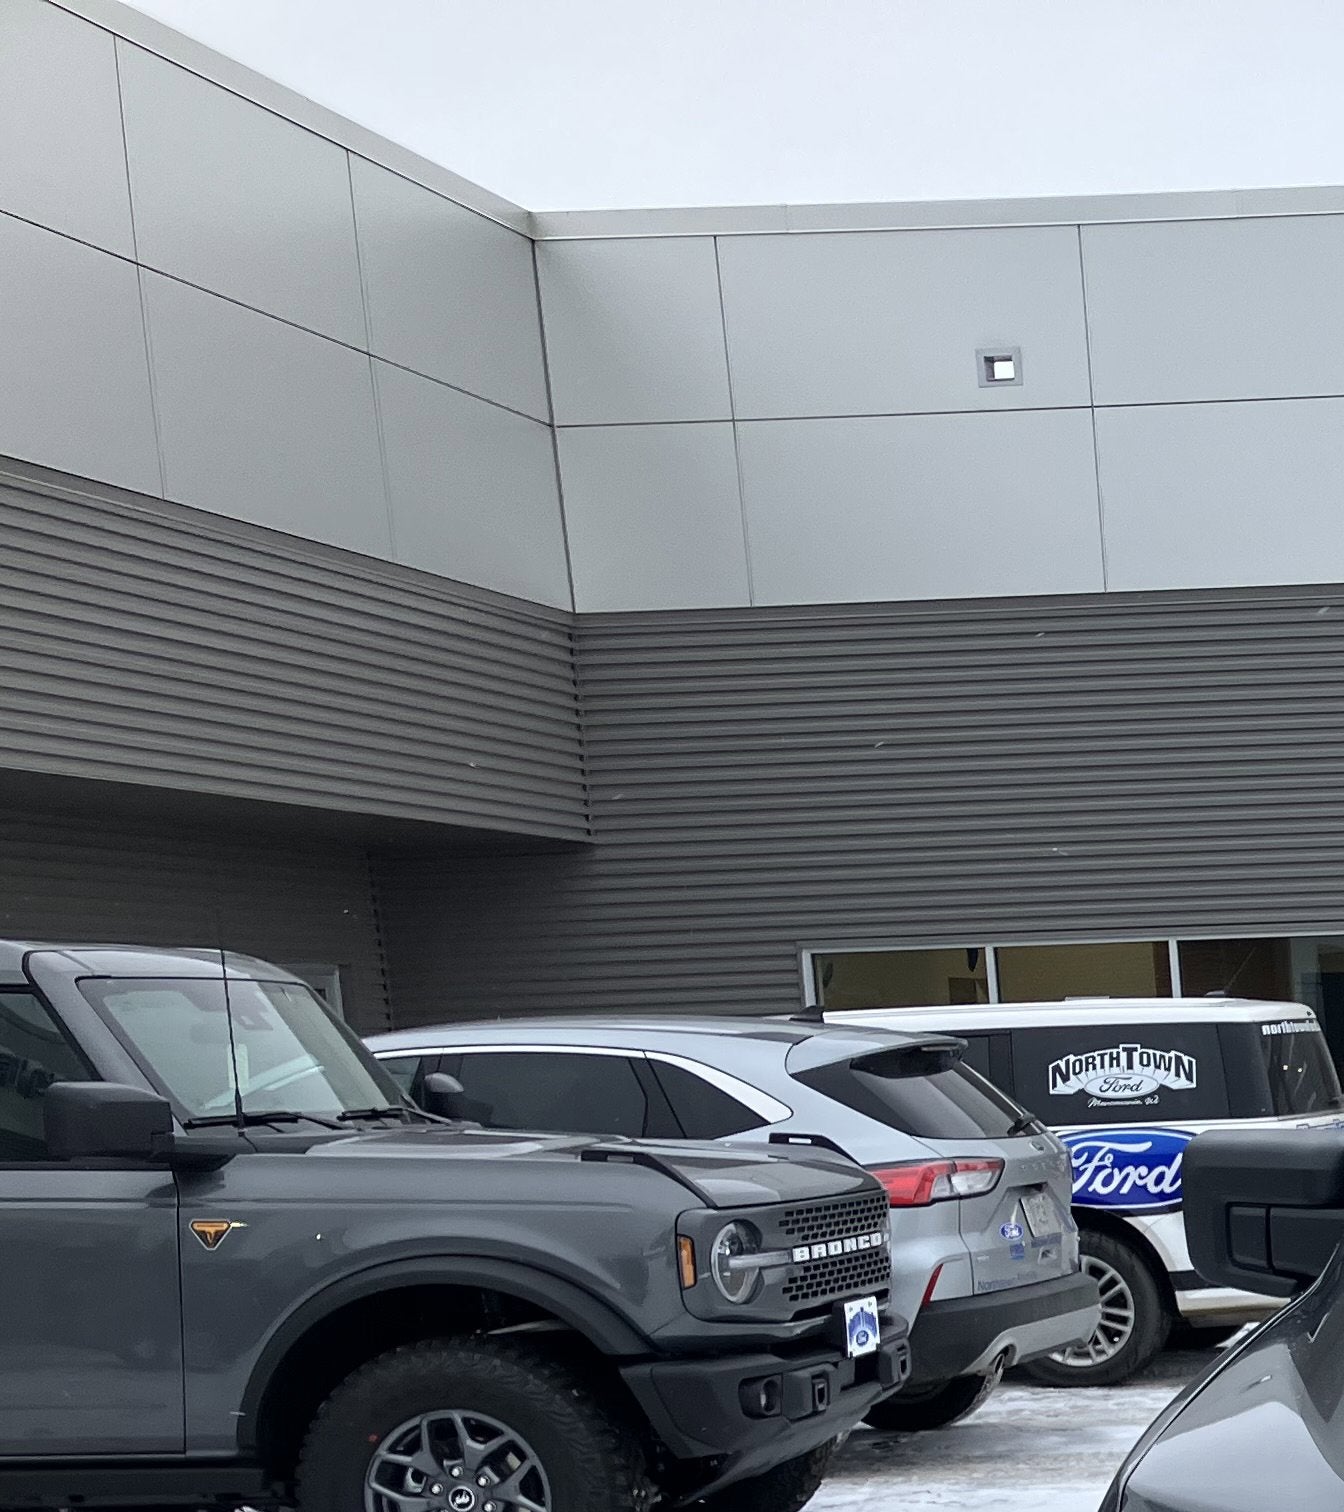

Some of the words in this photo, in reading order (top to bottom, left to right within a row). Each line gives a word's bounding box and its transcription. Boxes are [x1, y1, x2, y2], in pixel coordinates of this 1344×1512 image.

[1098, 1076, 1143, 1093] Ford
[1072, 1140, 1184, 1195] Ford
[792, 1232, 882, 1263] BRONCO
